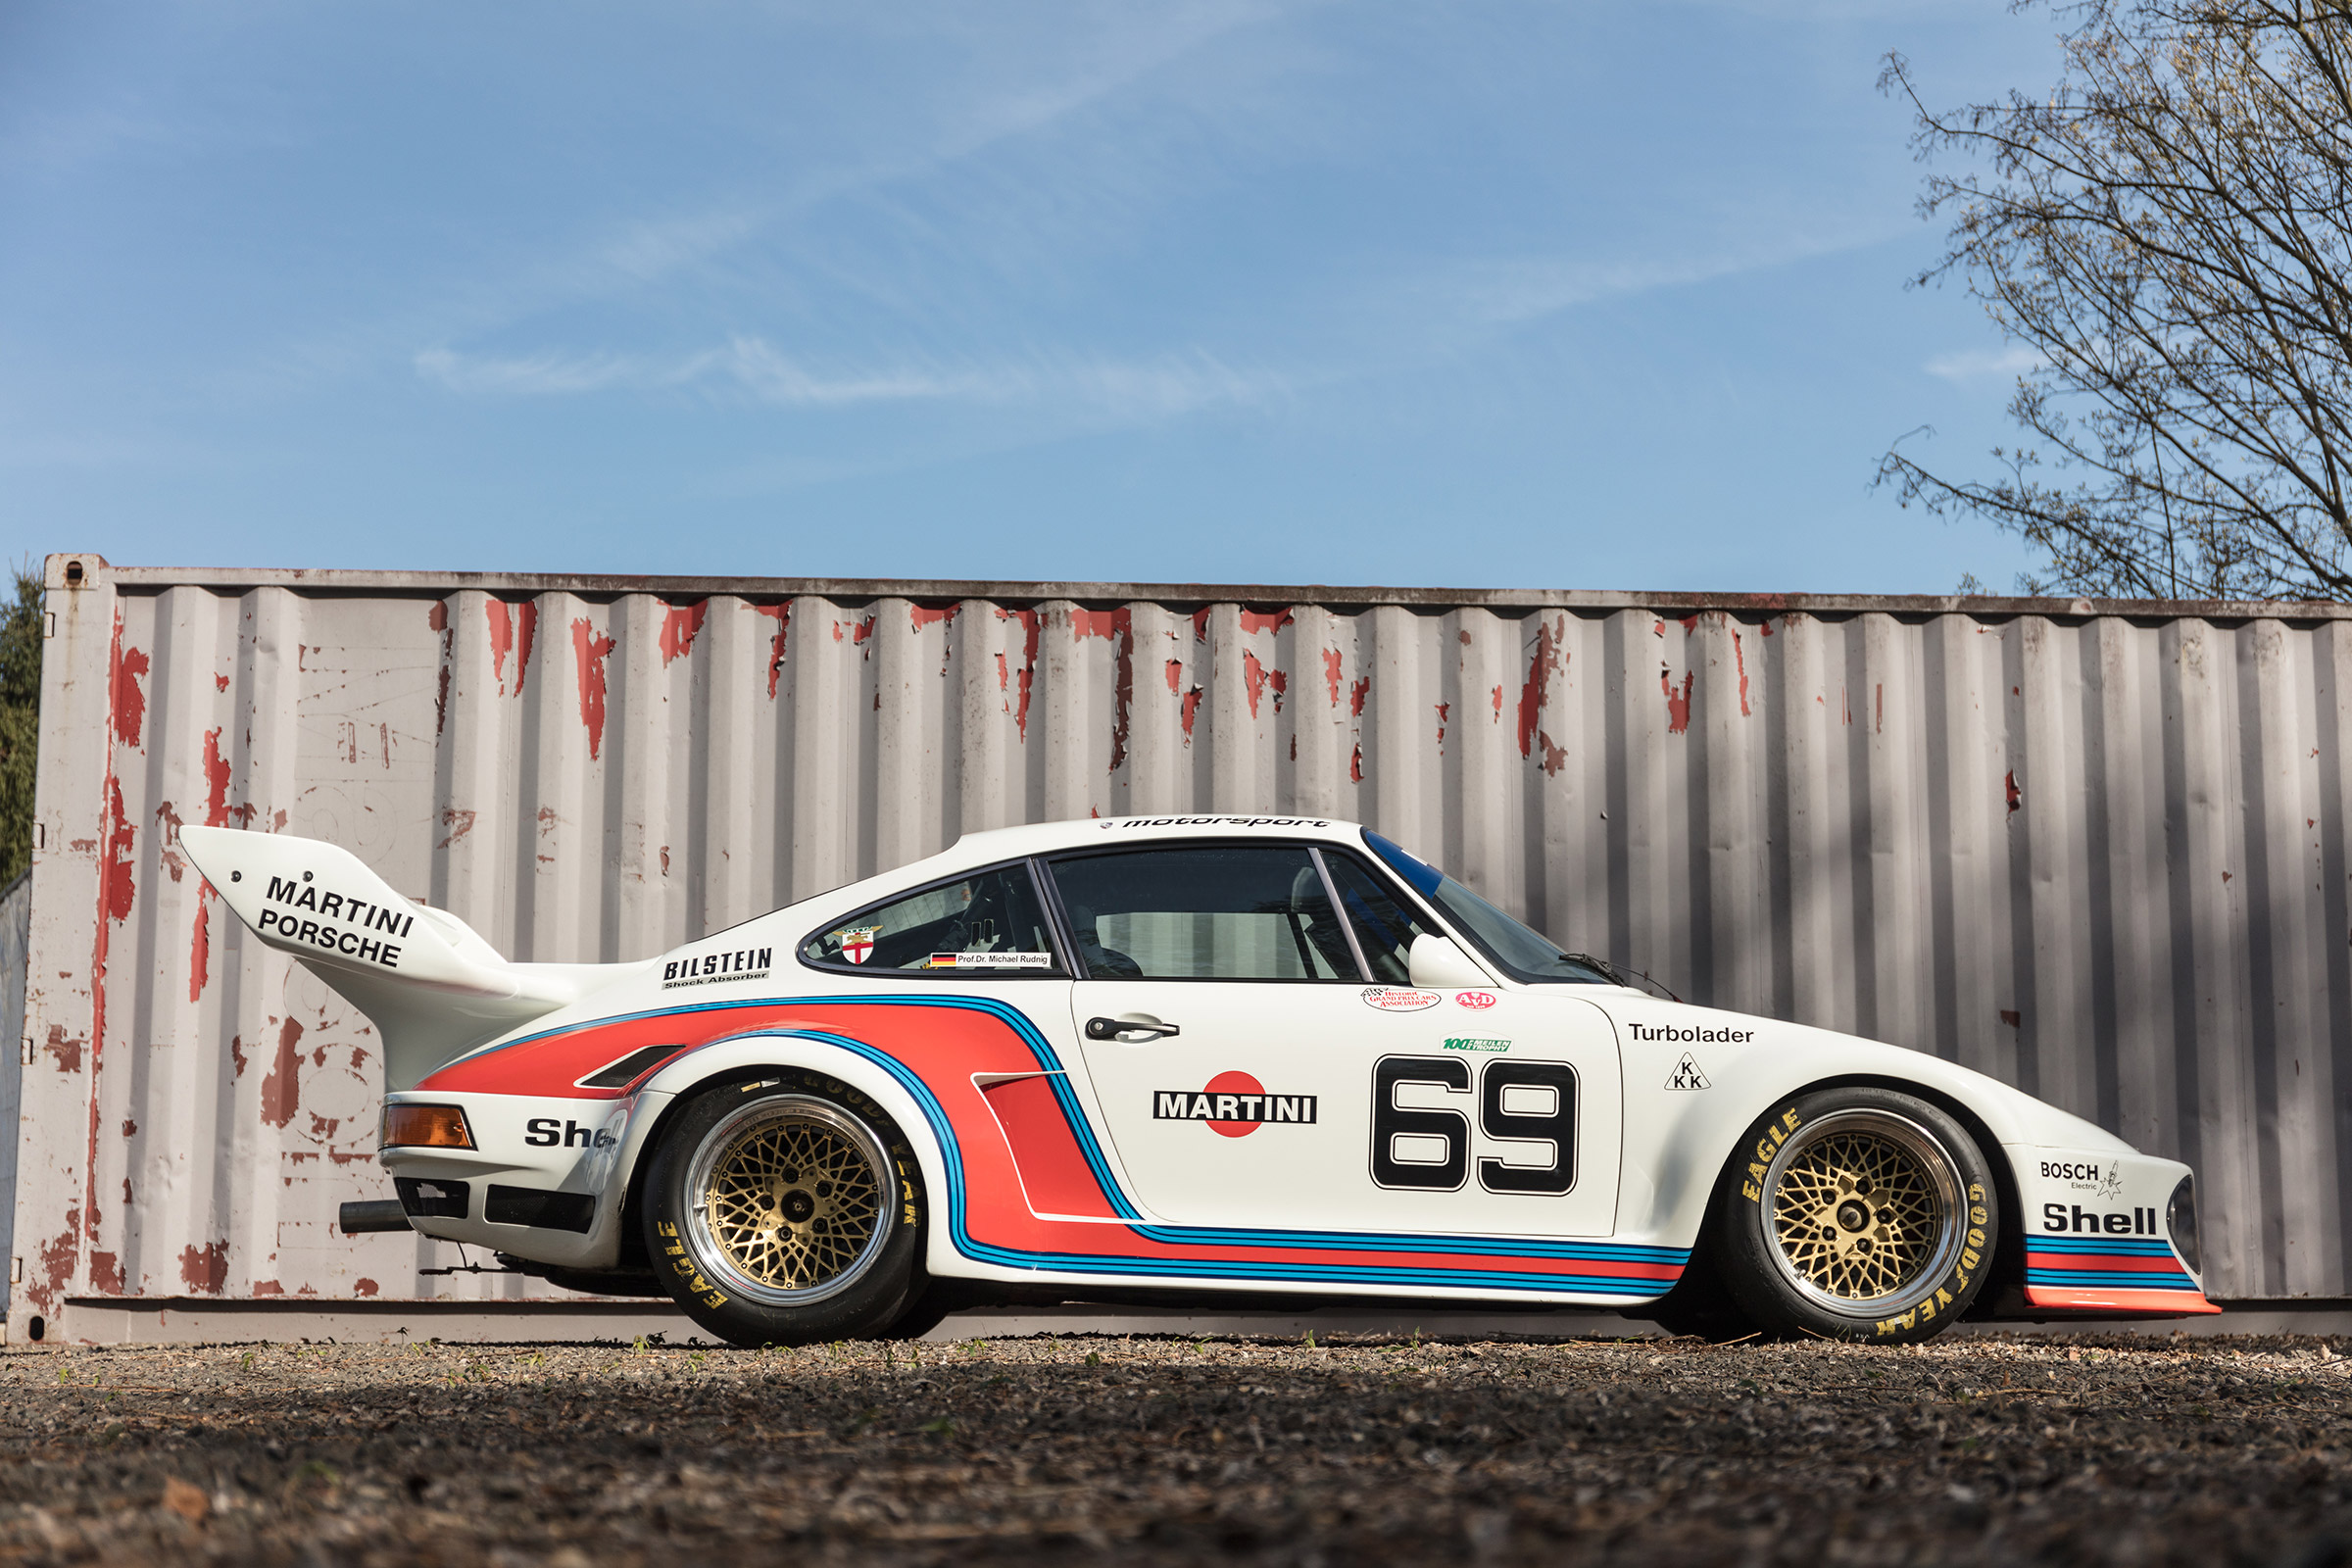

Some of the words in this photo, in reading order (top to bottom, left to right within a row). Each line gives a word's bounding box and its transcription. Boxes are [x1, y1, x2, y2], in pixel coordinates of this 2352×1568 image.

[1122, 817, 1331, 827] motorsport
[267, 876, 414, 938] MARTINI
[258, 908, 402, 967] PORSCHE
[663, 948, 772, 980] BILSTEIN
[1020, 956, 1048, 964] Rudnig
[664, 979, 704, 989] Shock
[709, 972, 767, 984] Absorber
[1628, 1023, 1754, 1043] Turbolader
[1158, 1093, 1311, 1122] MARTINI
[1368, 1054, 1581, 1197] 69
[1742, 1107, 1801, 1202] EAGLE
[2040, 1161, 2098, 1180] BOSCH
[2043, 1203, 2157, 1236] Shell
[658, 1221, 728, 1309] EAGLE
